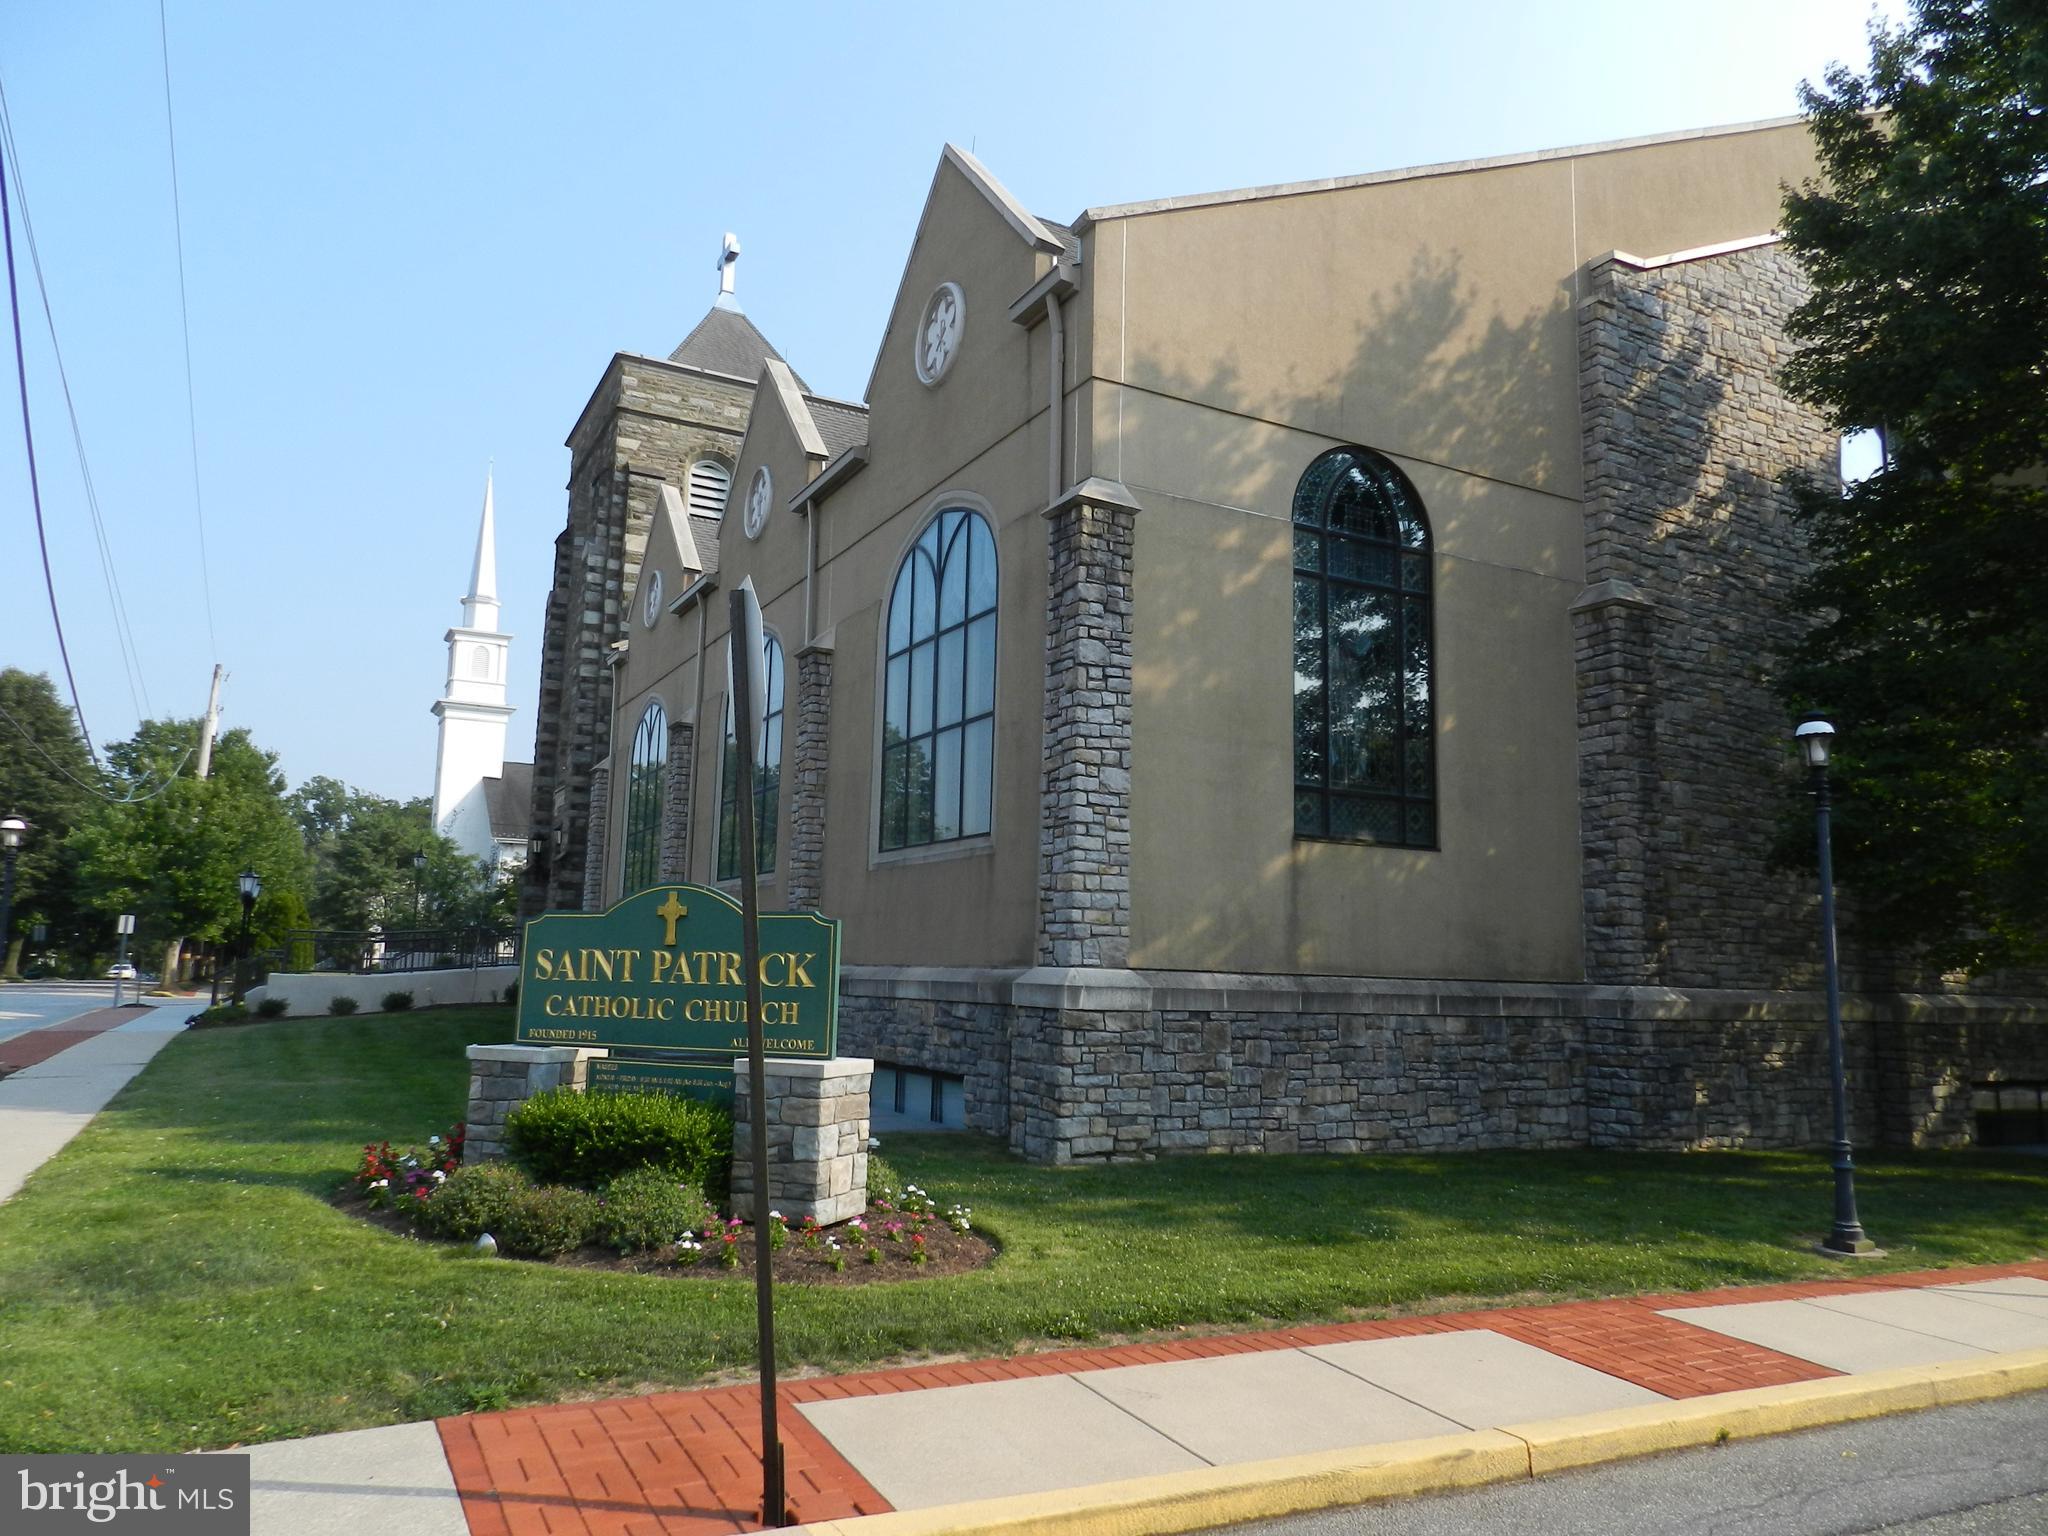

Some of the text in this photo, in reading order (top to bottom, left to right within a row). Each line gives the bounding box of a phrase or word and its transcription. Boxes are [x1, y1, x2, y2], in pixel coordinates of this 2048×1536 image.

[535, 948, 817, 988] SAINT PATRCK
[545, 994, 675, 1021] CATHOLIC
[528, 1028, 597, 1041] FOUNDED 1915
[762, 1038, 815, 1050] ELCOME
